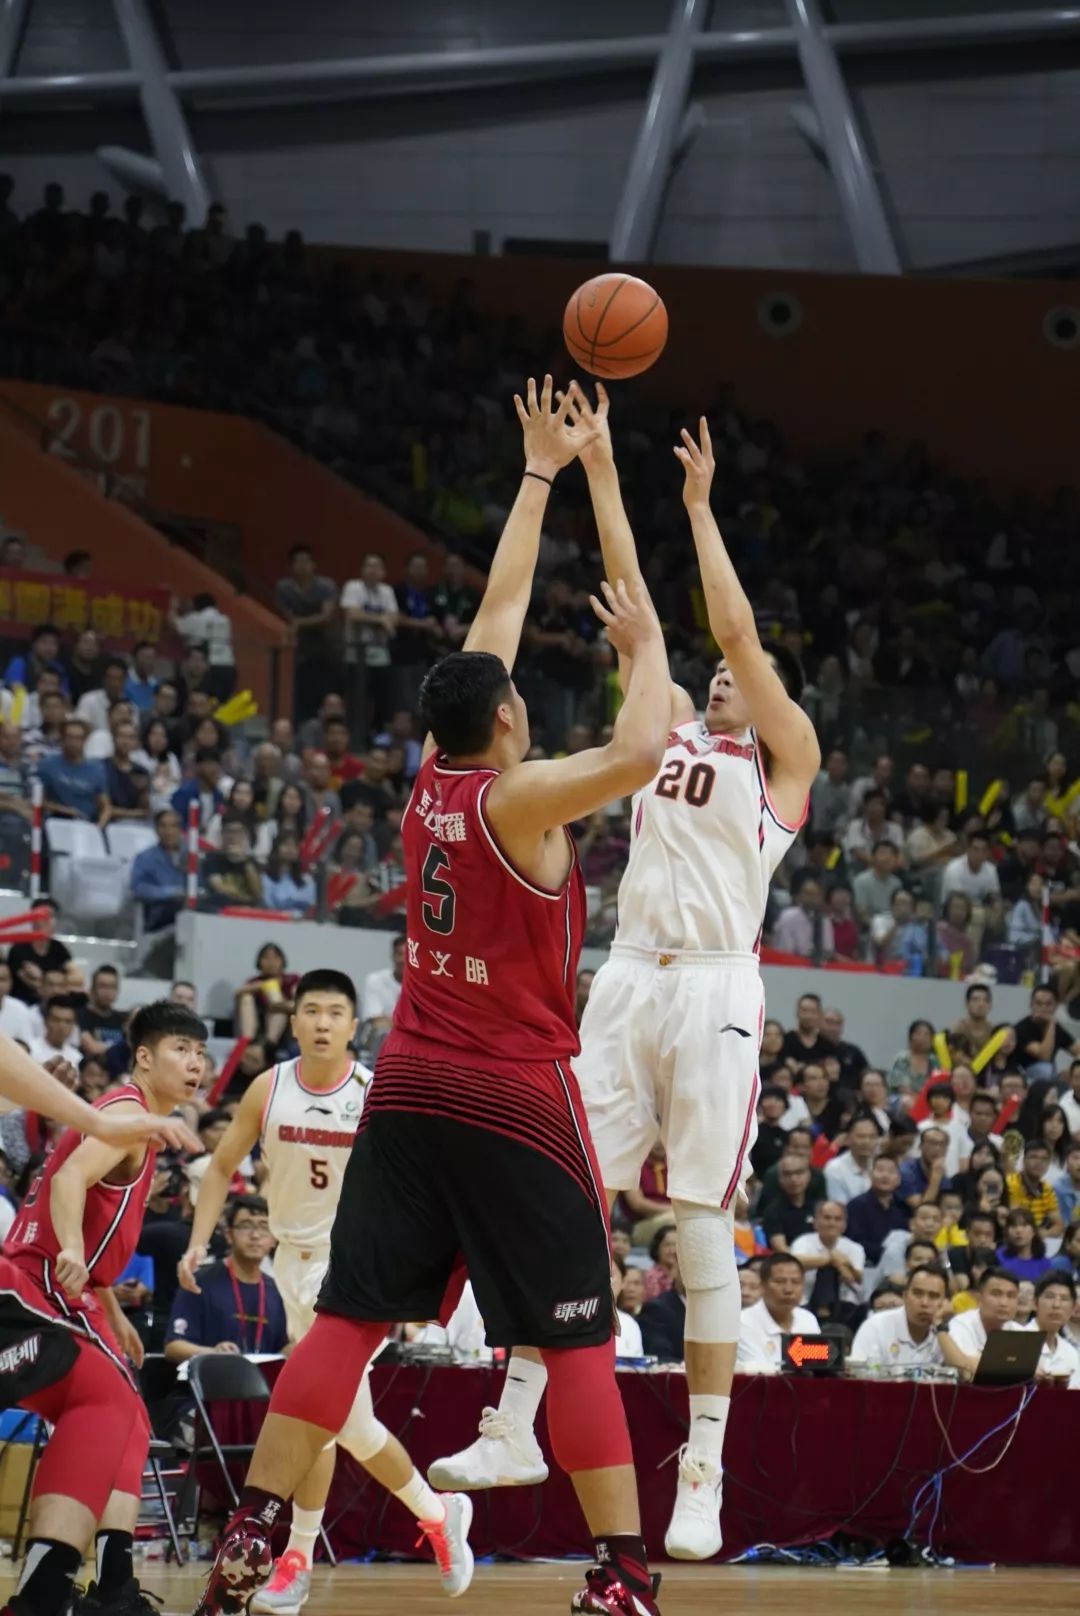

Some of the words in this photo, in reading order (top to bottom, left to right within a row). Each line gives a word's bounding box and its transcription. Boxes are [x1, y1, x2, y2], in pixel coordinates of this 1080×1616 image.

[48, 398, 150, 468] 201
[655, 759, 716, 808] 20
[421, 842, 456, 936] 5
[310, 1158, 329, 1190] 5
